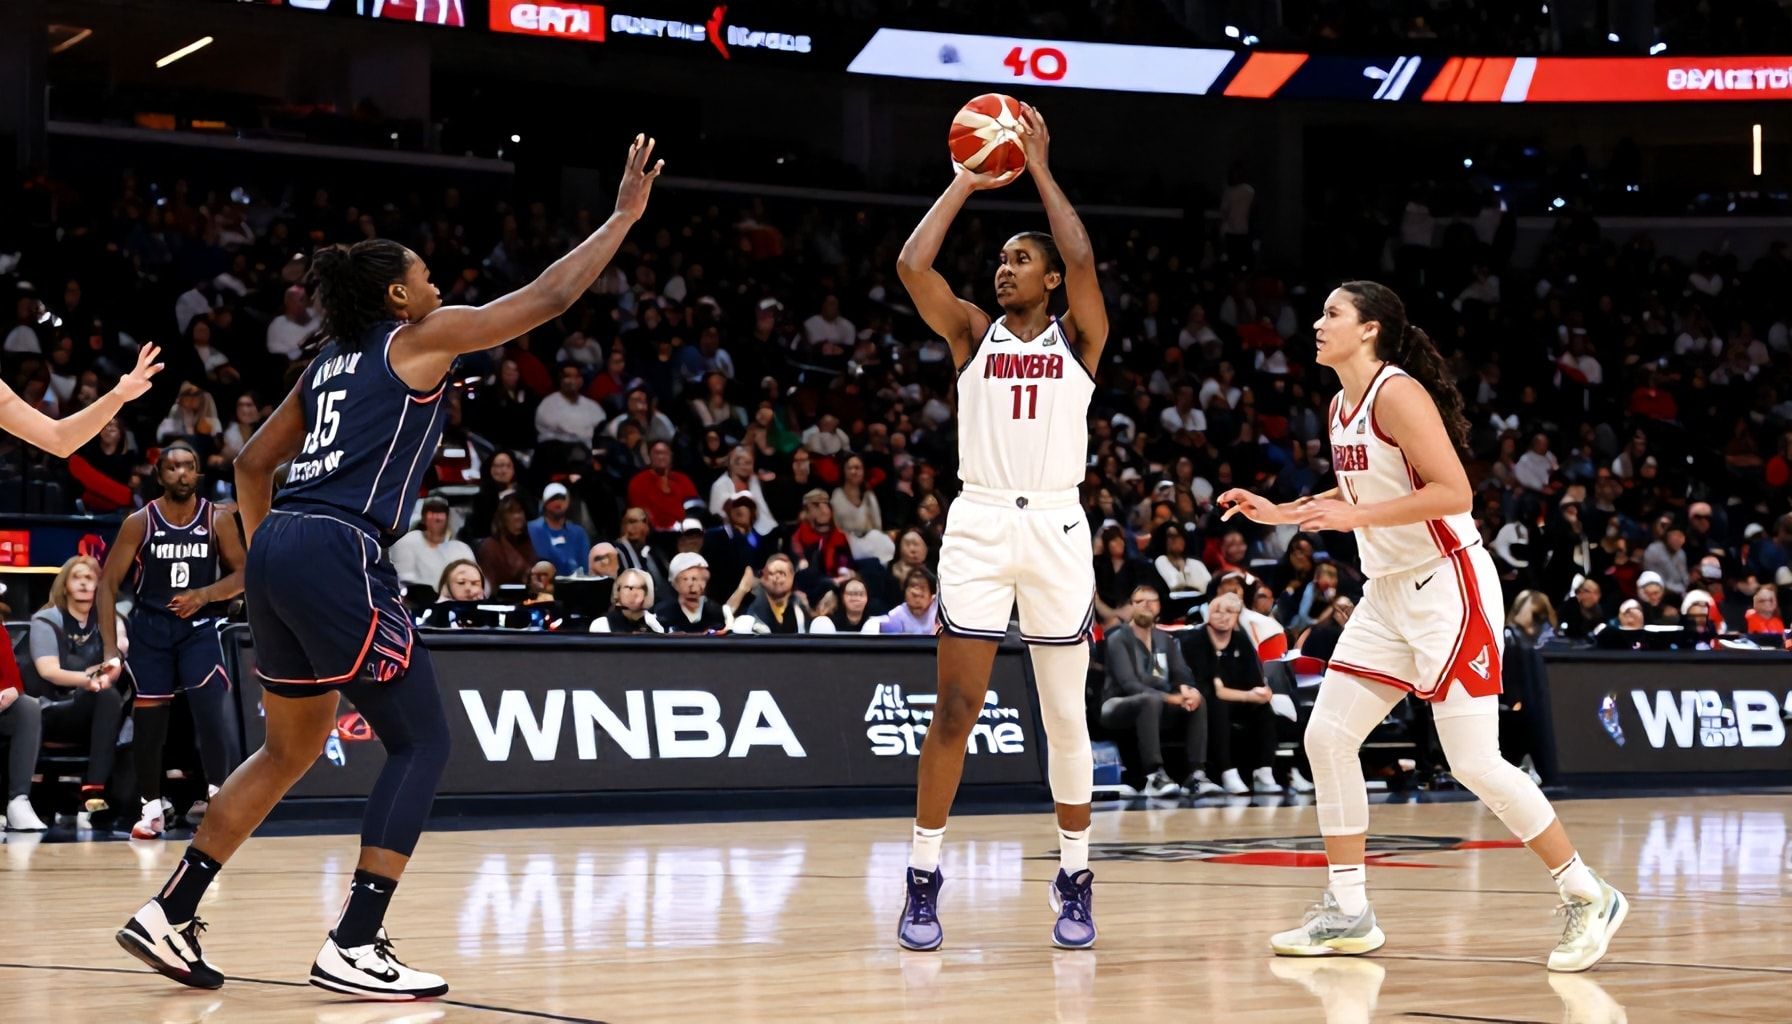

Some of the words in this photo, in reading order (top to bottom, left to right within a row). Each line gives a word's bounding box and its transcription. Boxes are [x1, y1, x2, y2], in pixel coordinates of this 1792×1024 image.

[1003, 46, 1068, 81] 40
[1011, 384, 1038, 420] 11
[459, 690, 807, 761] WNBA
